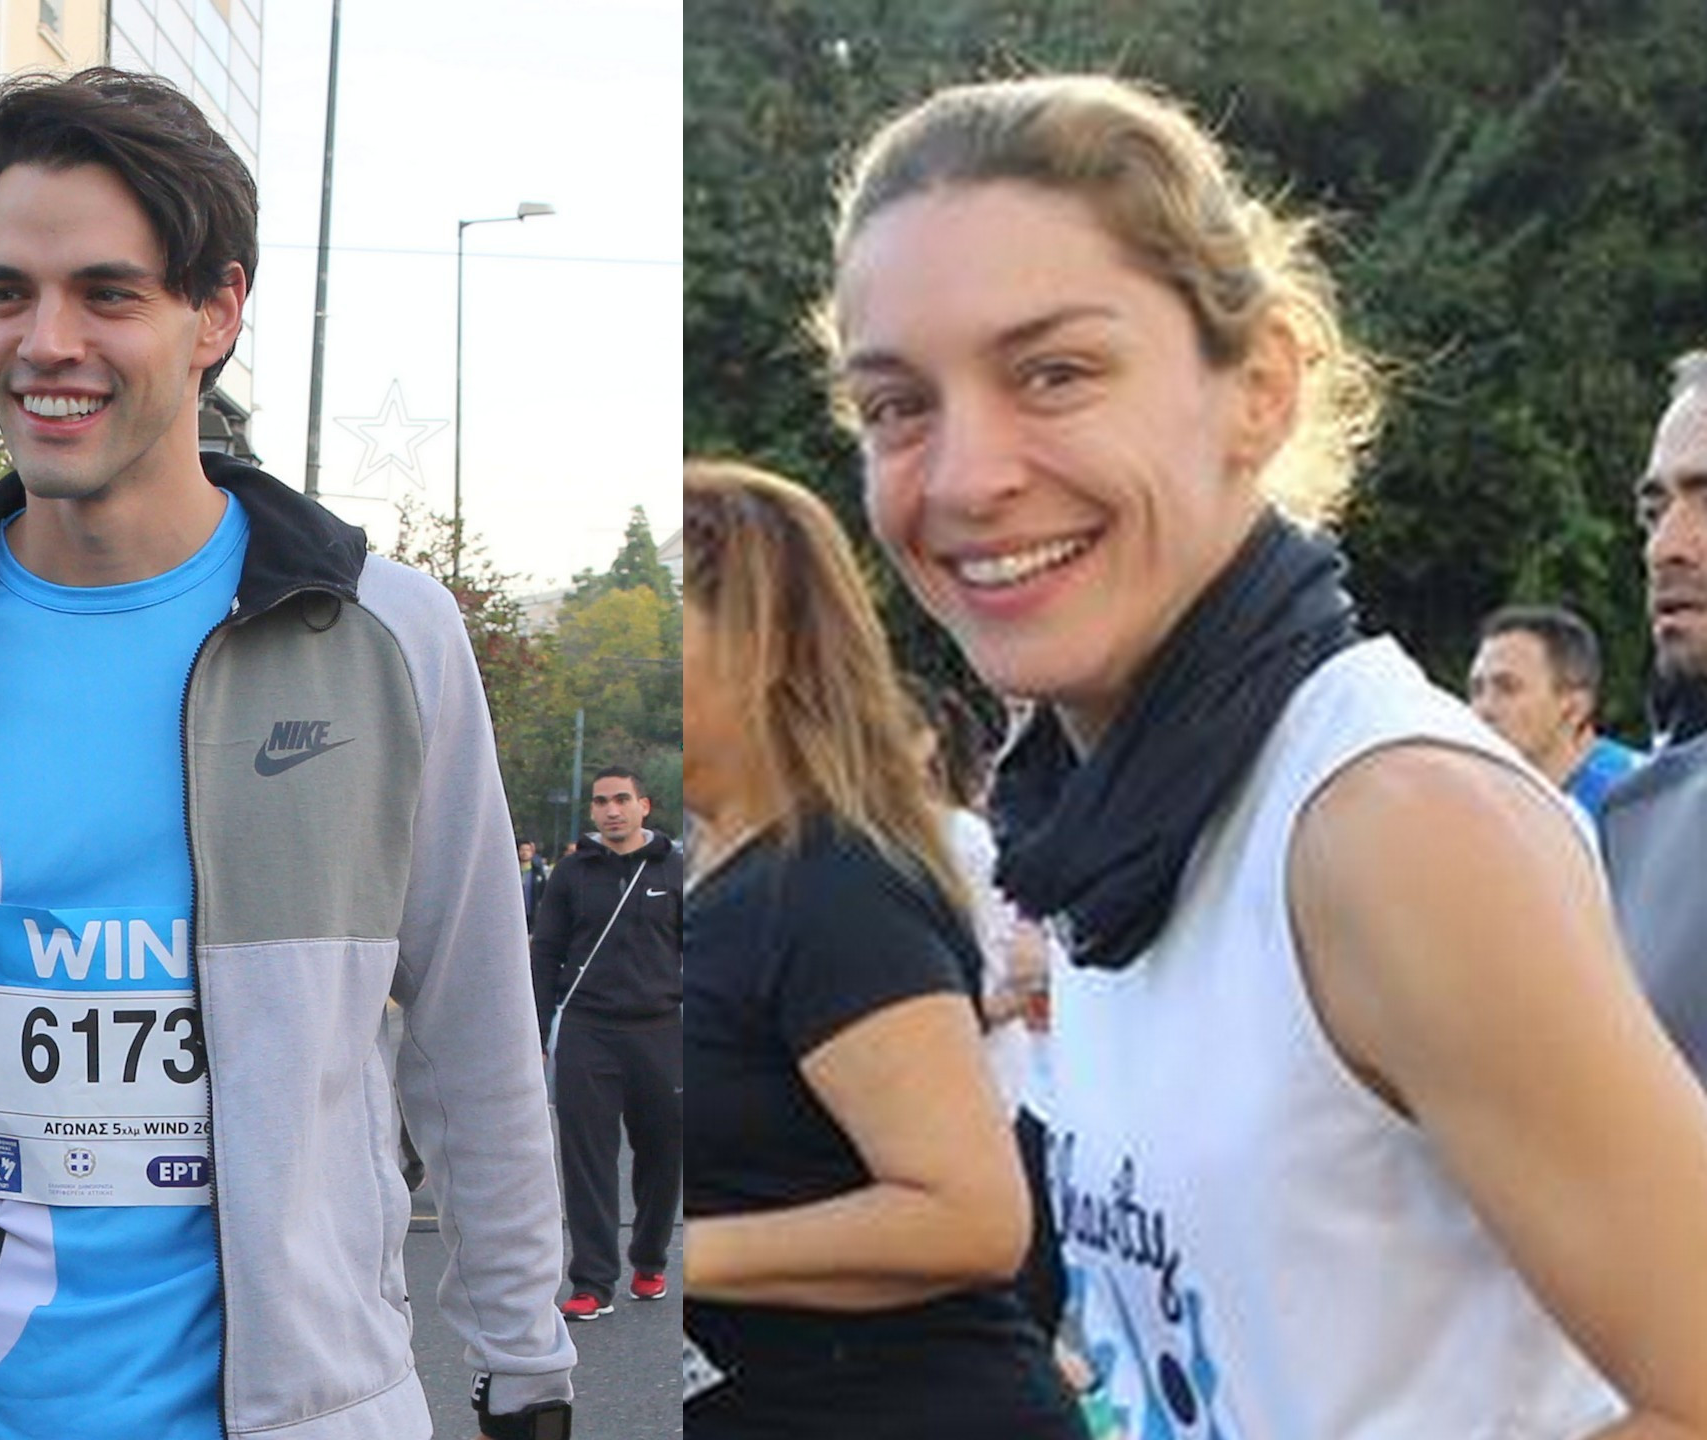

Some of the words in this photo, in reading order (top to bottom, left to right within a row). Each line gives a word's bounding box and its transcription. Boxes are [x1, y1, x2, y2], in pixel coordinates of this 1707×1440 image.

[268, 721, 331, 751] NIKE
[21, 1006, 206, 1084] 6173
[44, 1122, 109, 1135] ΑΓΩΝΑΣ
[144, 1122, 189, 1135] WIND
